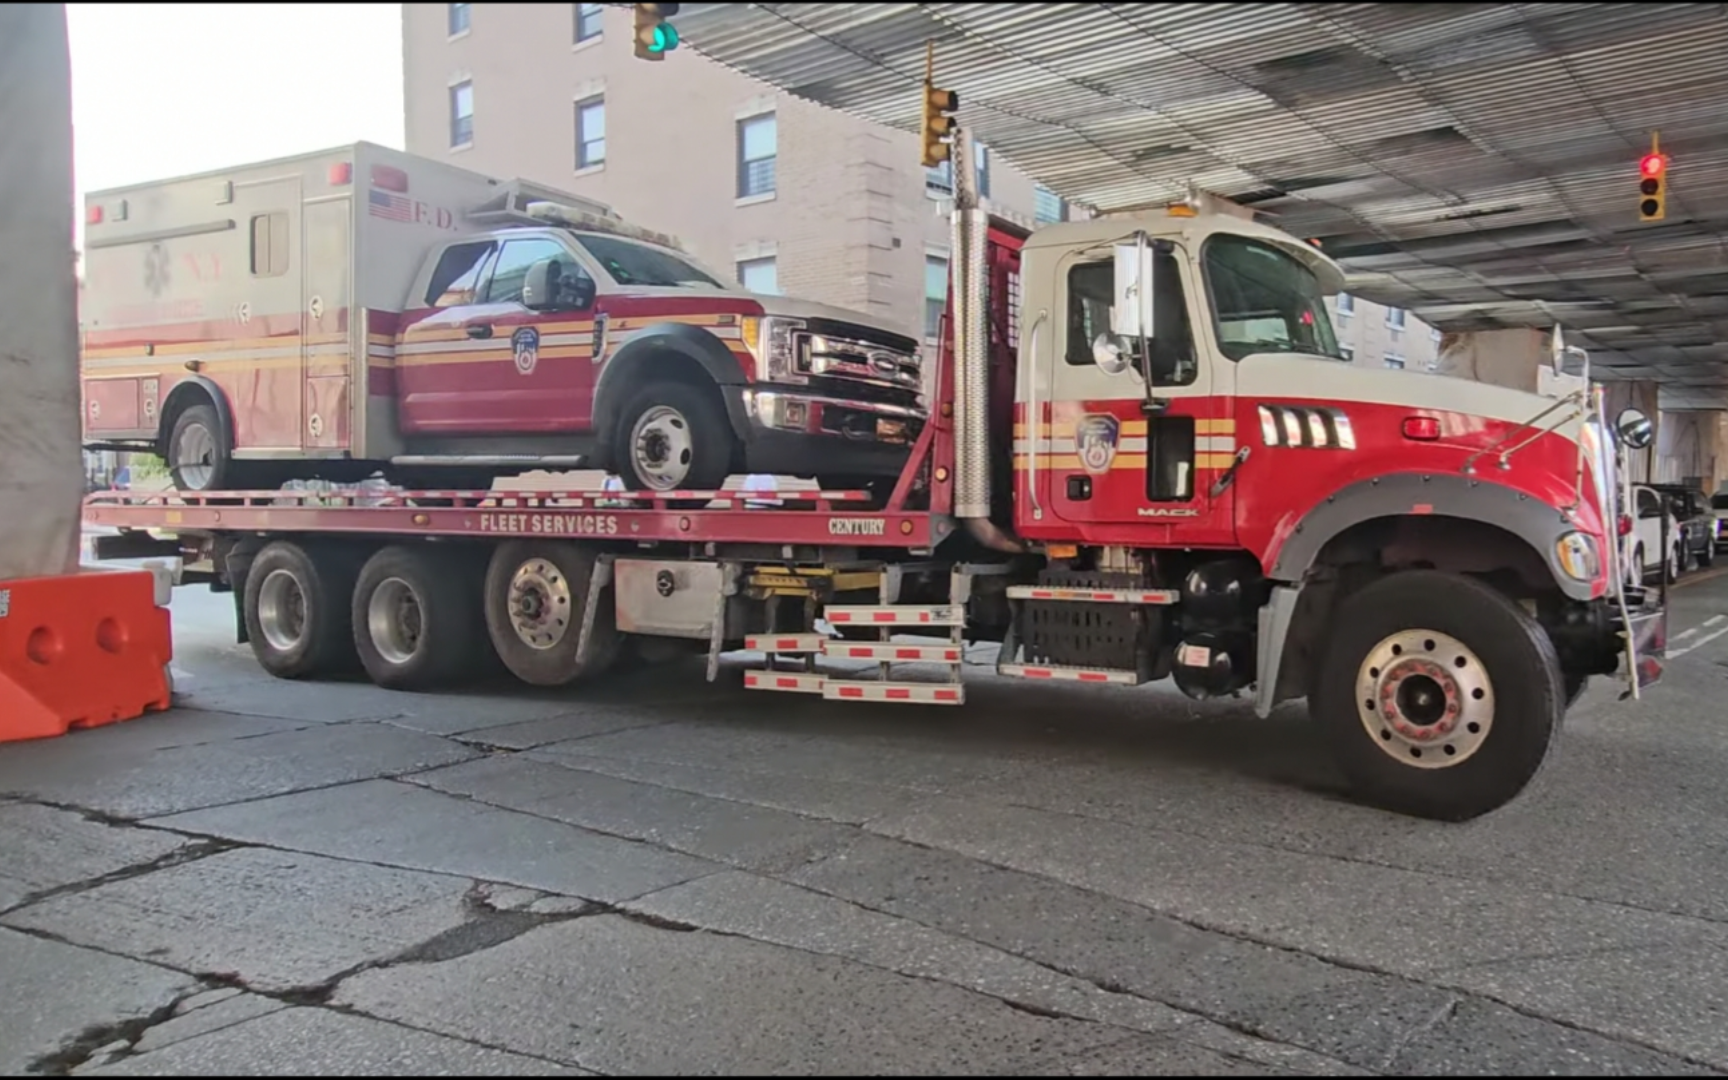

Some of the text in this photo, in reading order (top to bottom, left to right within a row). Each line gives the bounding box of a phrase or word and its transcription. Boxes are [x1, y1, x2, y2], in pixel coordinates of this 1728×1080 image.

[1136, 507, 1200, 517] MACK
[480, 514, 618, 534] FLEET SERVICES
[828, 517, 886, 536] CENTURY
